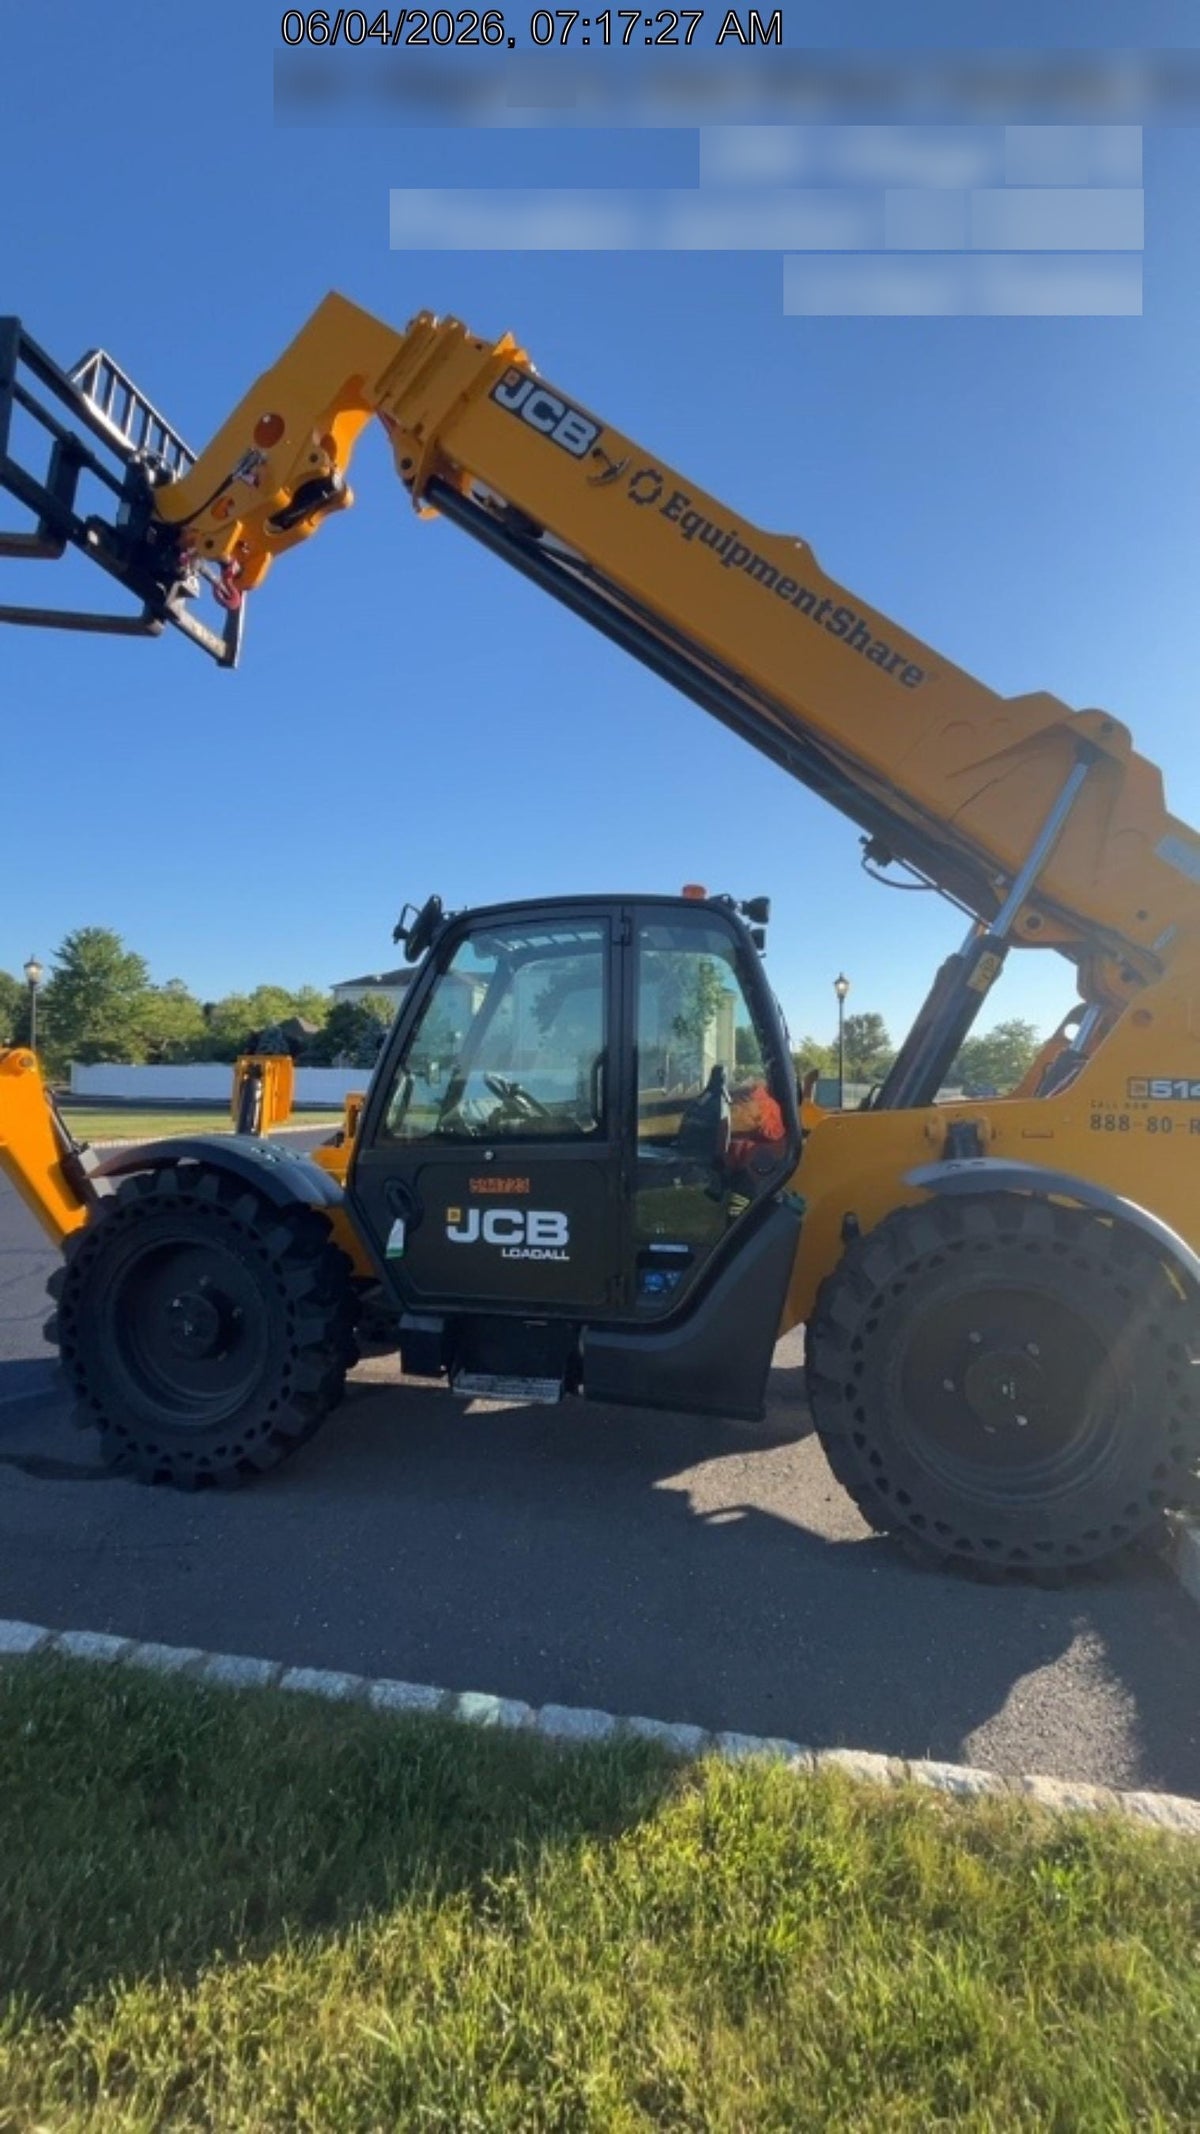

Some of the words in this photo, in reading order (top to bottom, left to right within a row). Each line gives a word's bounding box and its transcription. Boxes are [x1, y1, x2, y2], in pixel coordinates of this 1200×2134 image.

[493, 368, 598, 456] JCB
[659, 490, 925, 689] EquipmentShare
[446, 1207, 570, 1247] JCB
[501, 1247, 571, 1261] LOADALL
